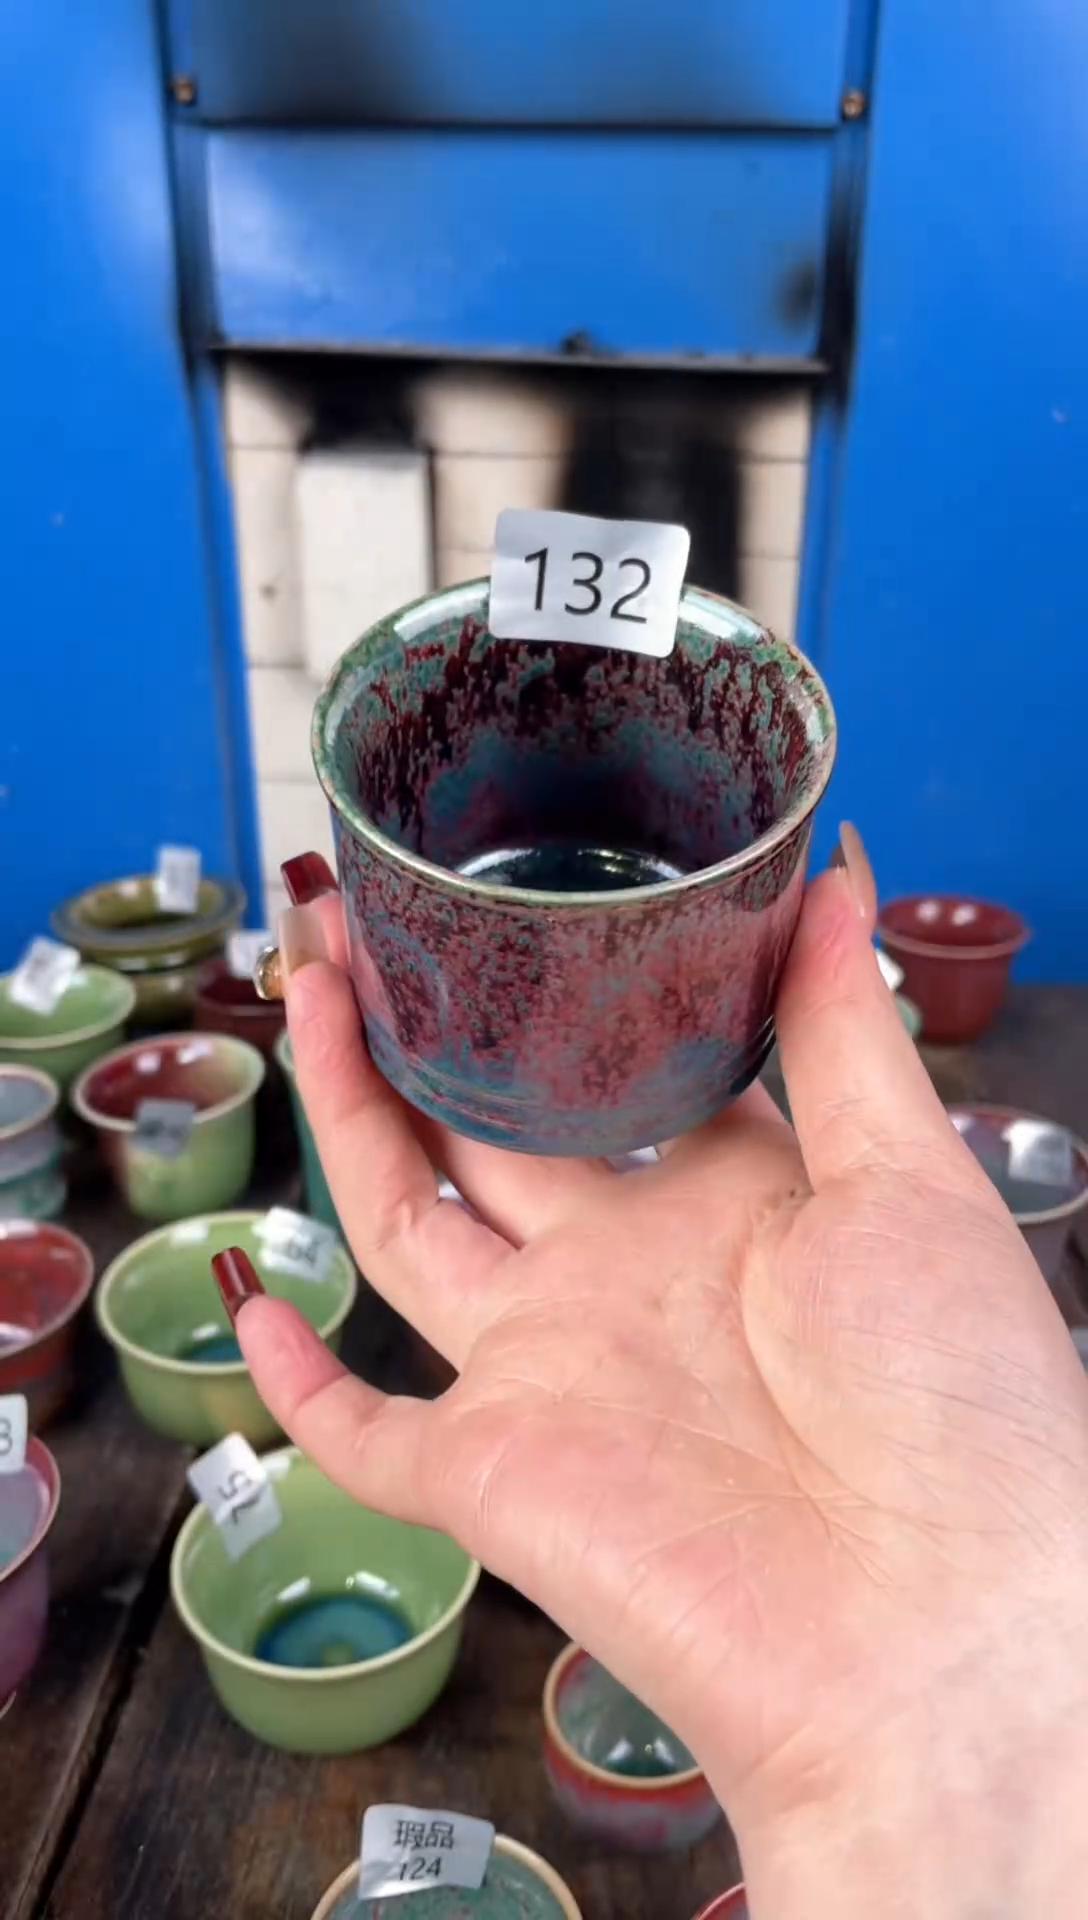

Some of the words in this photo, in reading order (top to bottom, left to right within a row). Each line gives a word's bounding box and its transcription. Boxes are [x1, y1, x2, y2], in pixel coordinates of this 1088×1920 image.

[524, 547, 652, 624] 132
[393, 1820, 455, 1851] 瑕品
[400, 1857, 442, 1880] 124
